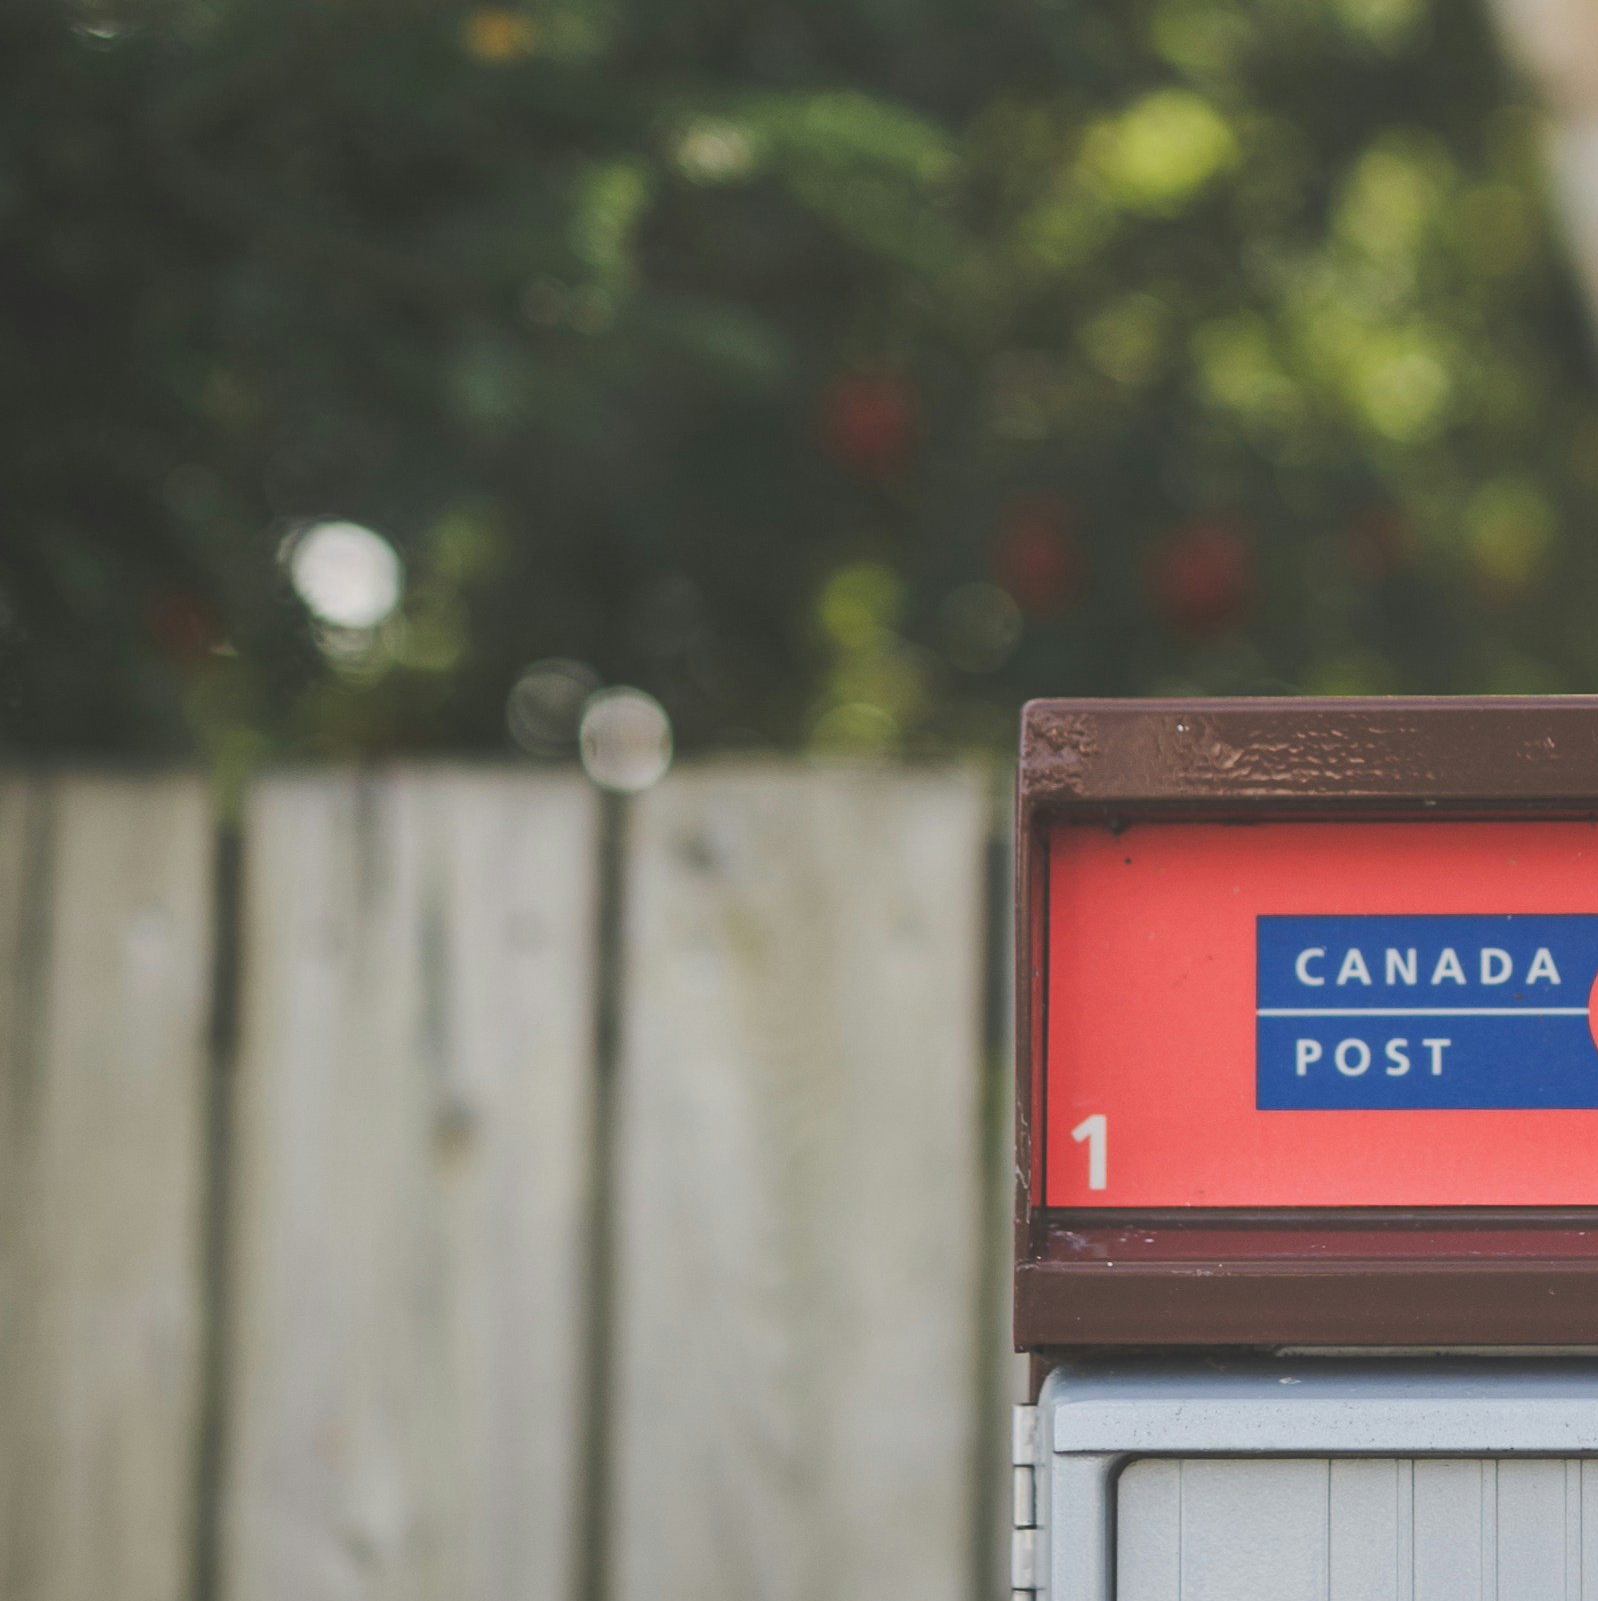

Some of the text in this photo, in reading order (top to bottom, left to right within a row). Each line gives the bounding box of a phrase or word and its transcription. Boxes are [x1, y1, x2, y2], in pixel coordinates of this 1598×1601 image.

[1295, 947, 1561, 986] CANADA
[1296, 1037, 1451, 1077] POST
[1071, 1114, 1107, 1190] 1
